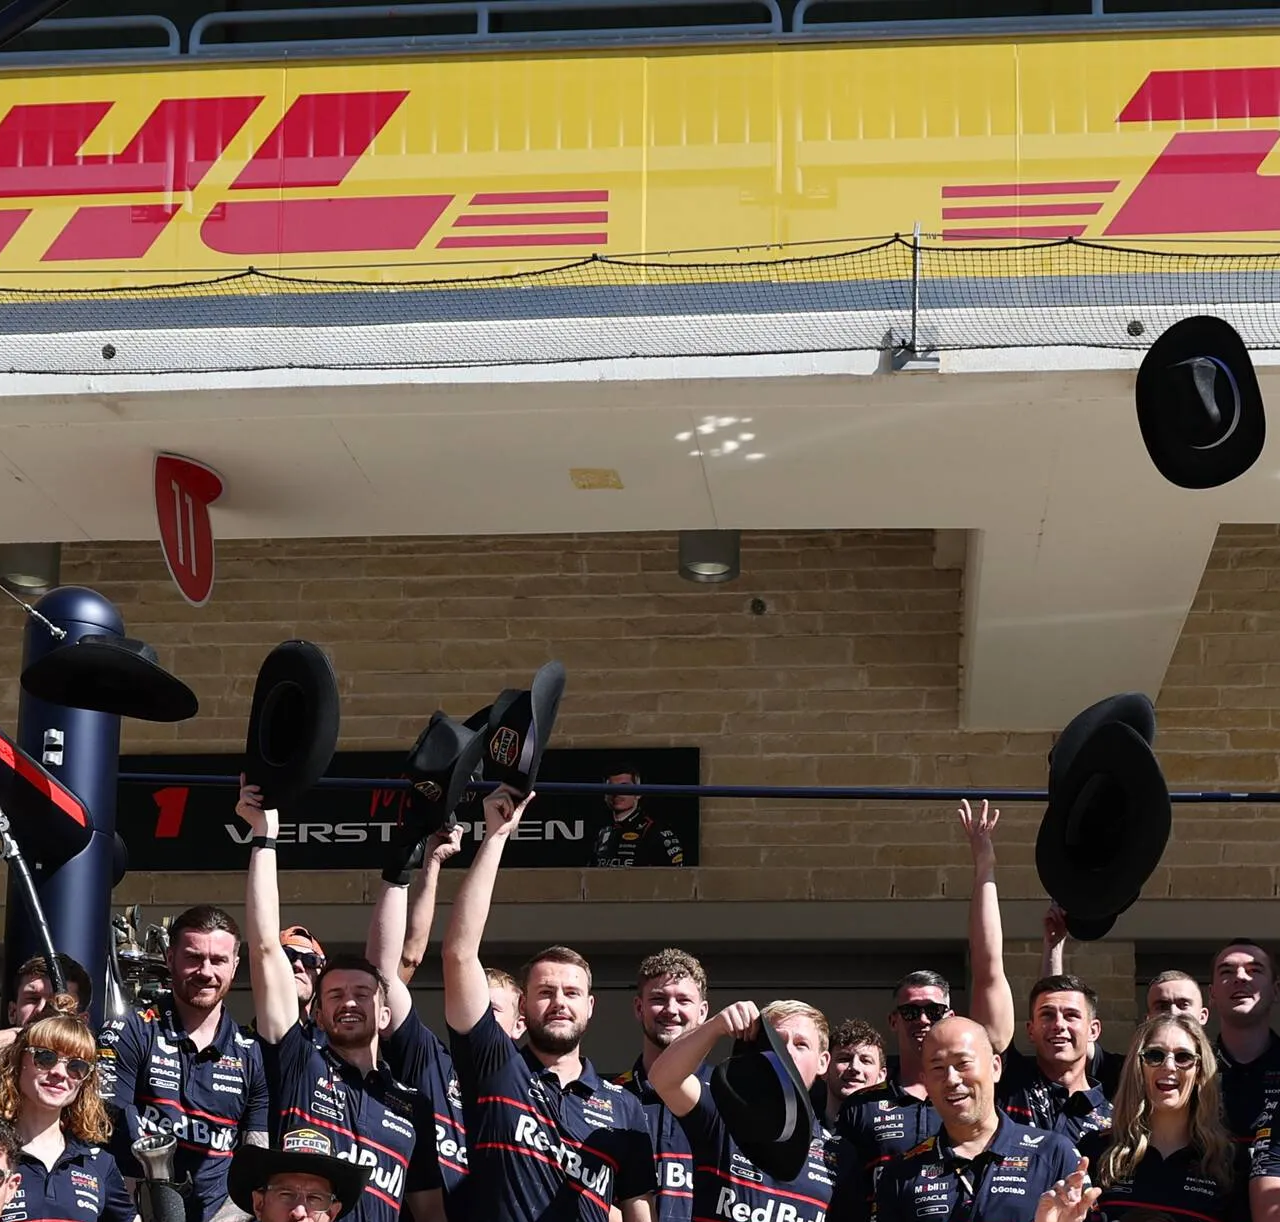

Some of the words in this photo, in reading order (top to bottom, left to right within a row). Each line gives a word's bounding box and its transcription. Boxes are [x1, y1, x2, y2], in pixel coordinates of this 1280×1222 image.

[152, 787, 189, 838] 1
[150, 1067, 181, 1079] ORACLE
[213, 1073, 243, 1083] HONDA
[874, 1123, 904, 1131] ORACLE
[191, 1119, 238, 1151] Bull
[286, 1139, 301, 1148] PIT
[302, 1139, 328, 1149] CREW
[567, 1150, 610, 1197] Bull
[915, 1194, 948, 1204] ORACLE
